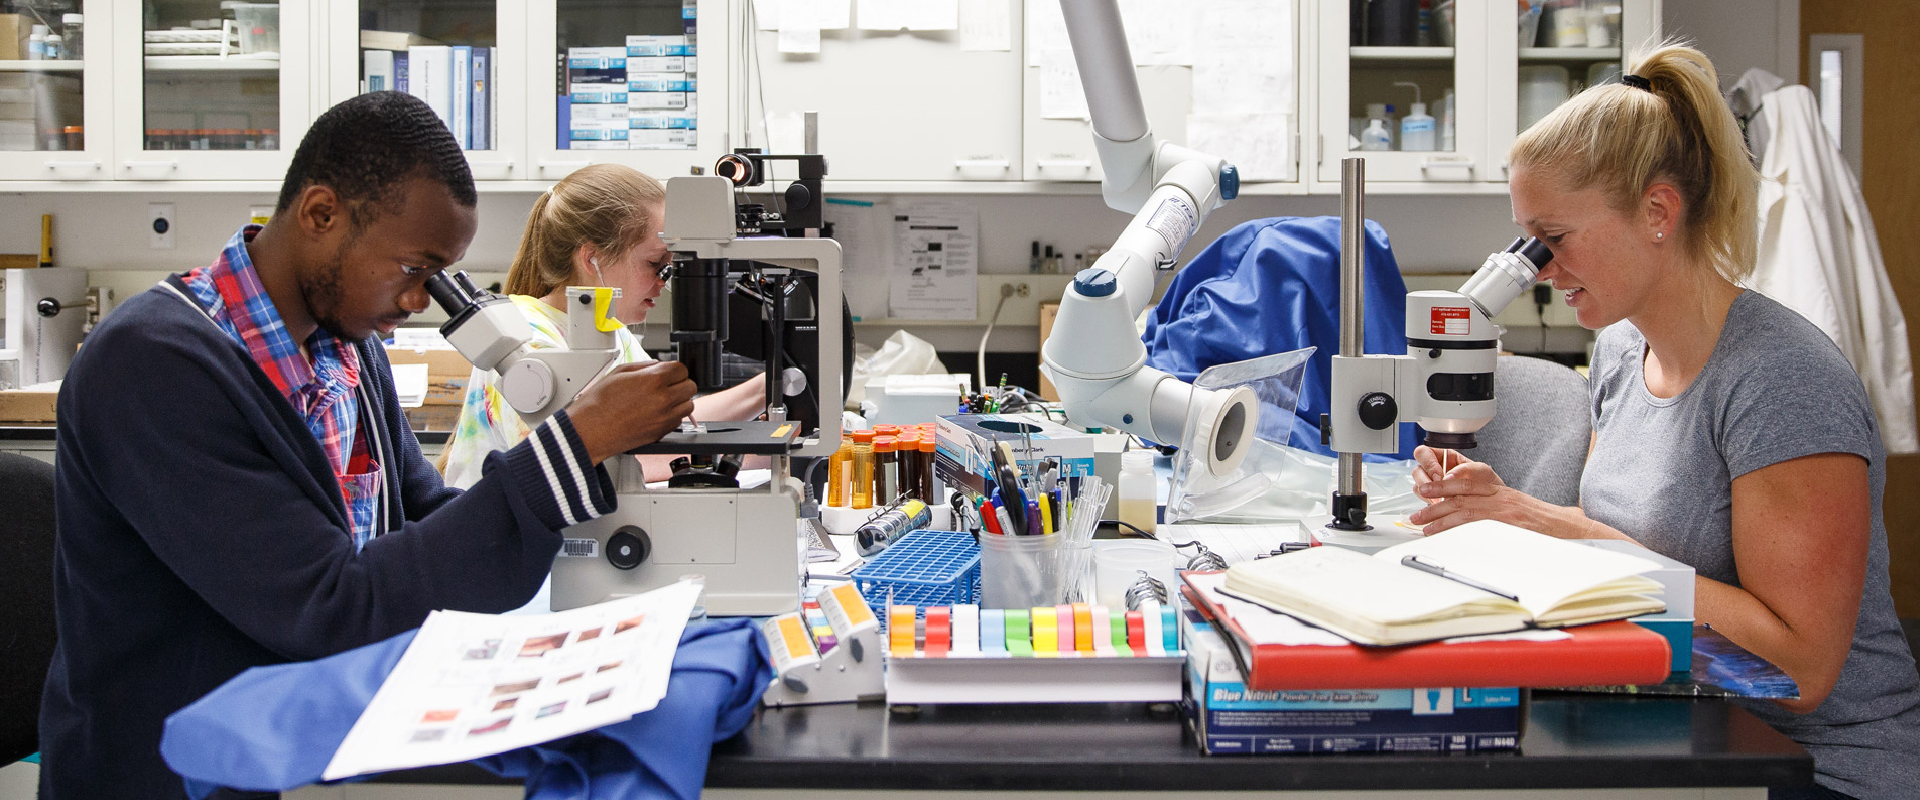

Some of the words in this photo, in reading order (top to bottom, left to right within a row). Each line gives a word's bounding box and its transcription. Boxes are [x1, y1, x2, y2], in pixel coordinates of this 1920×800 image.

[1367, 396, 1387, 404] TENSION
[1062, 463, 1072, 473] M
[1213, 688, 1242, 702] Blue
[1243, 689, 1280, 702] Nitrile
[1494, 737, 1515, 747] N440
